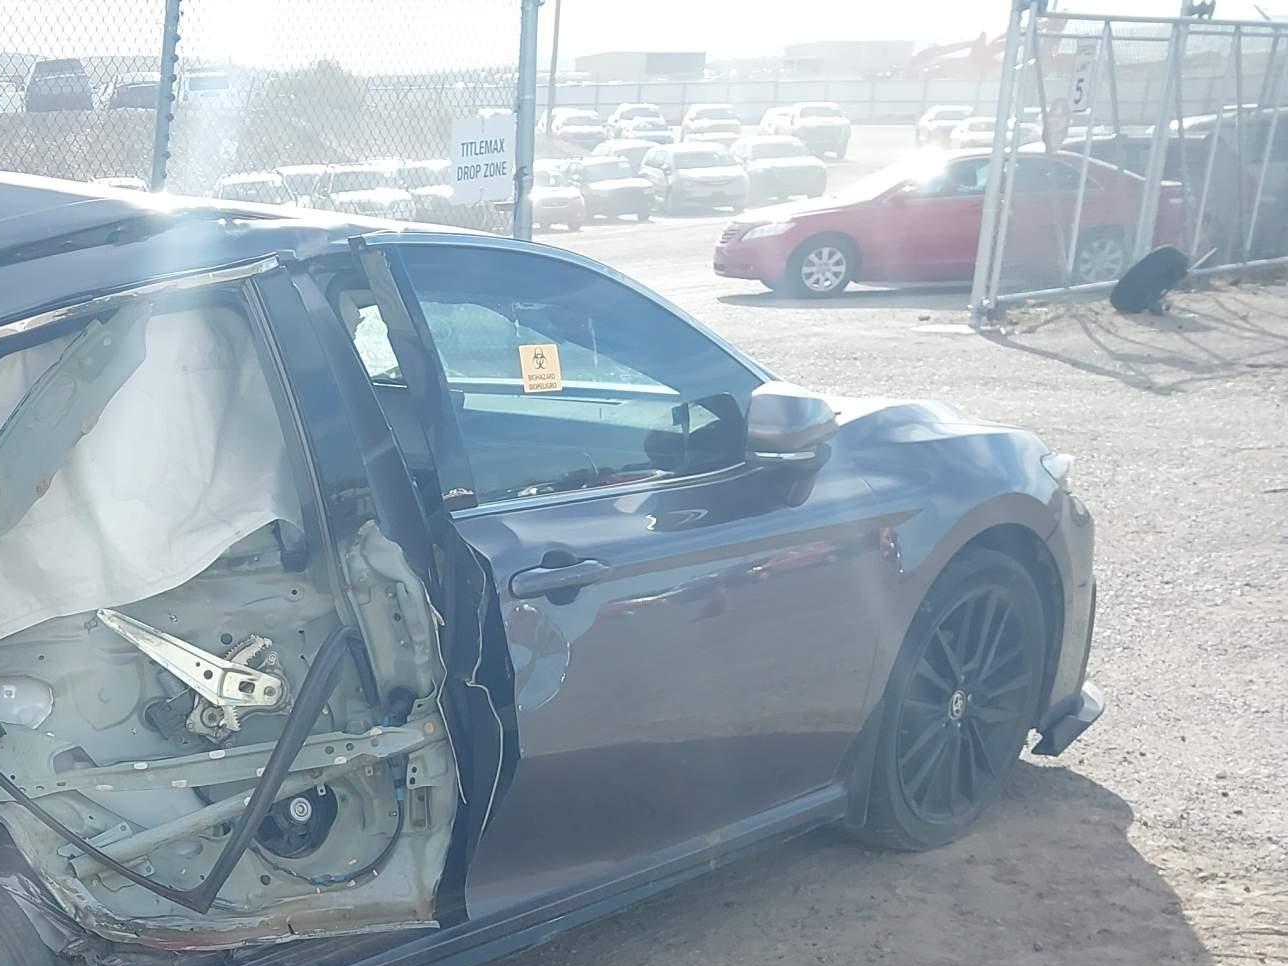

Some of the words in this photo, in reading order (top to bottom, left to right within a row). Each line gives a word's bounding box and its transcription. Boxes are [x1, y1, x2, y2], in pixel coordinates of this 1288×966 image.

[460, 139, 505, 157] TITLEMAX
[457, 165, 481, 181] DROP
[483, 161, 507, 178] ZONE
